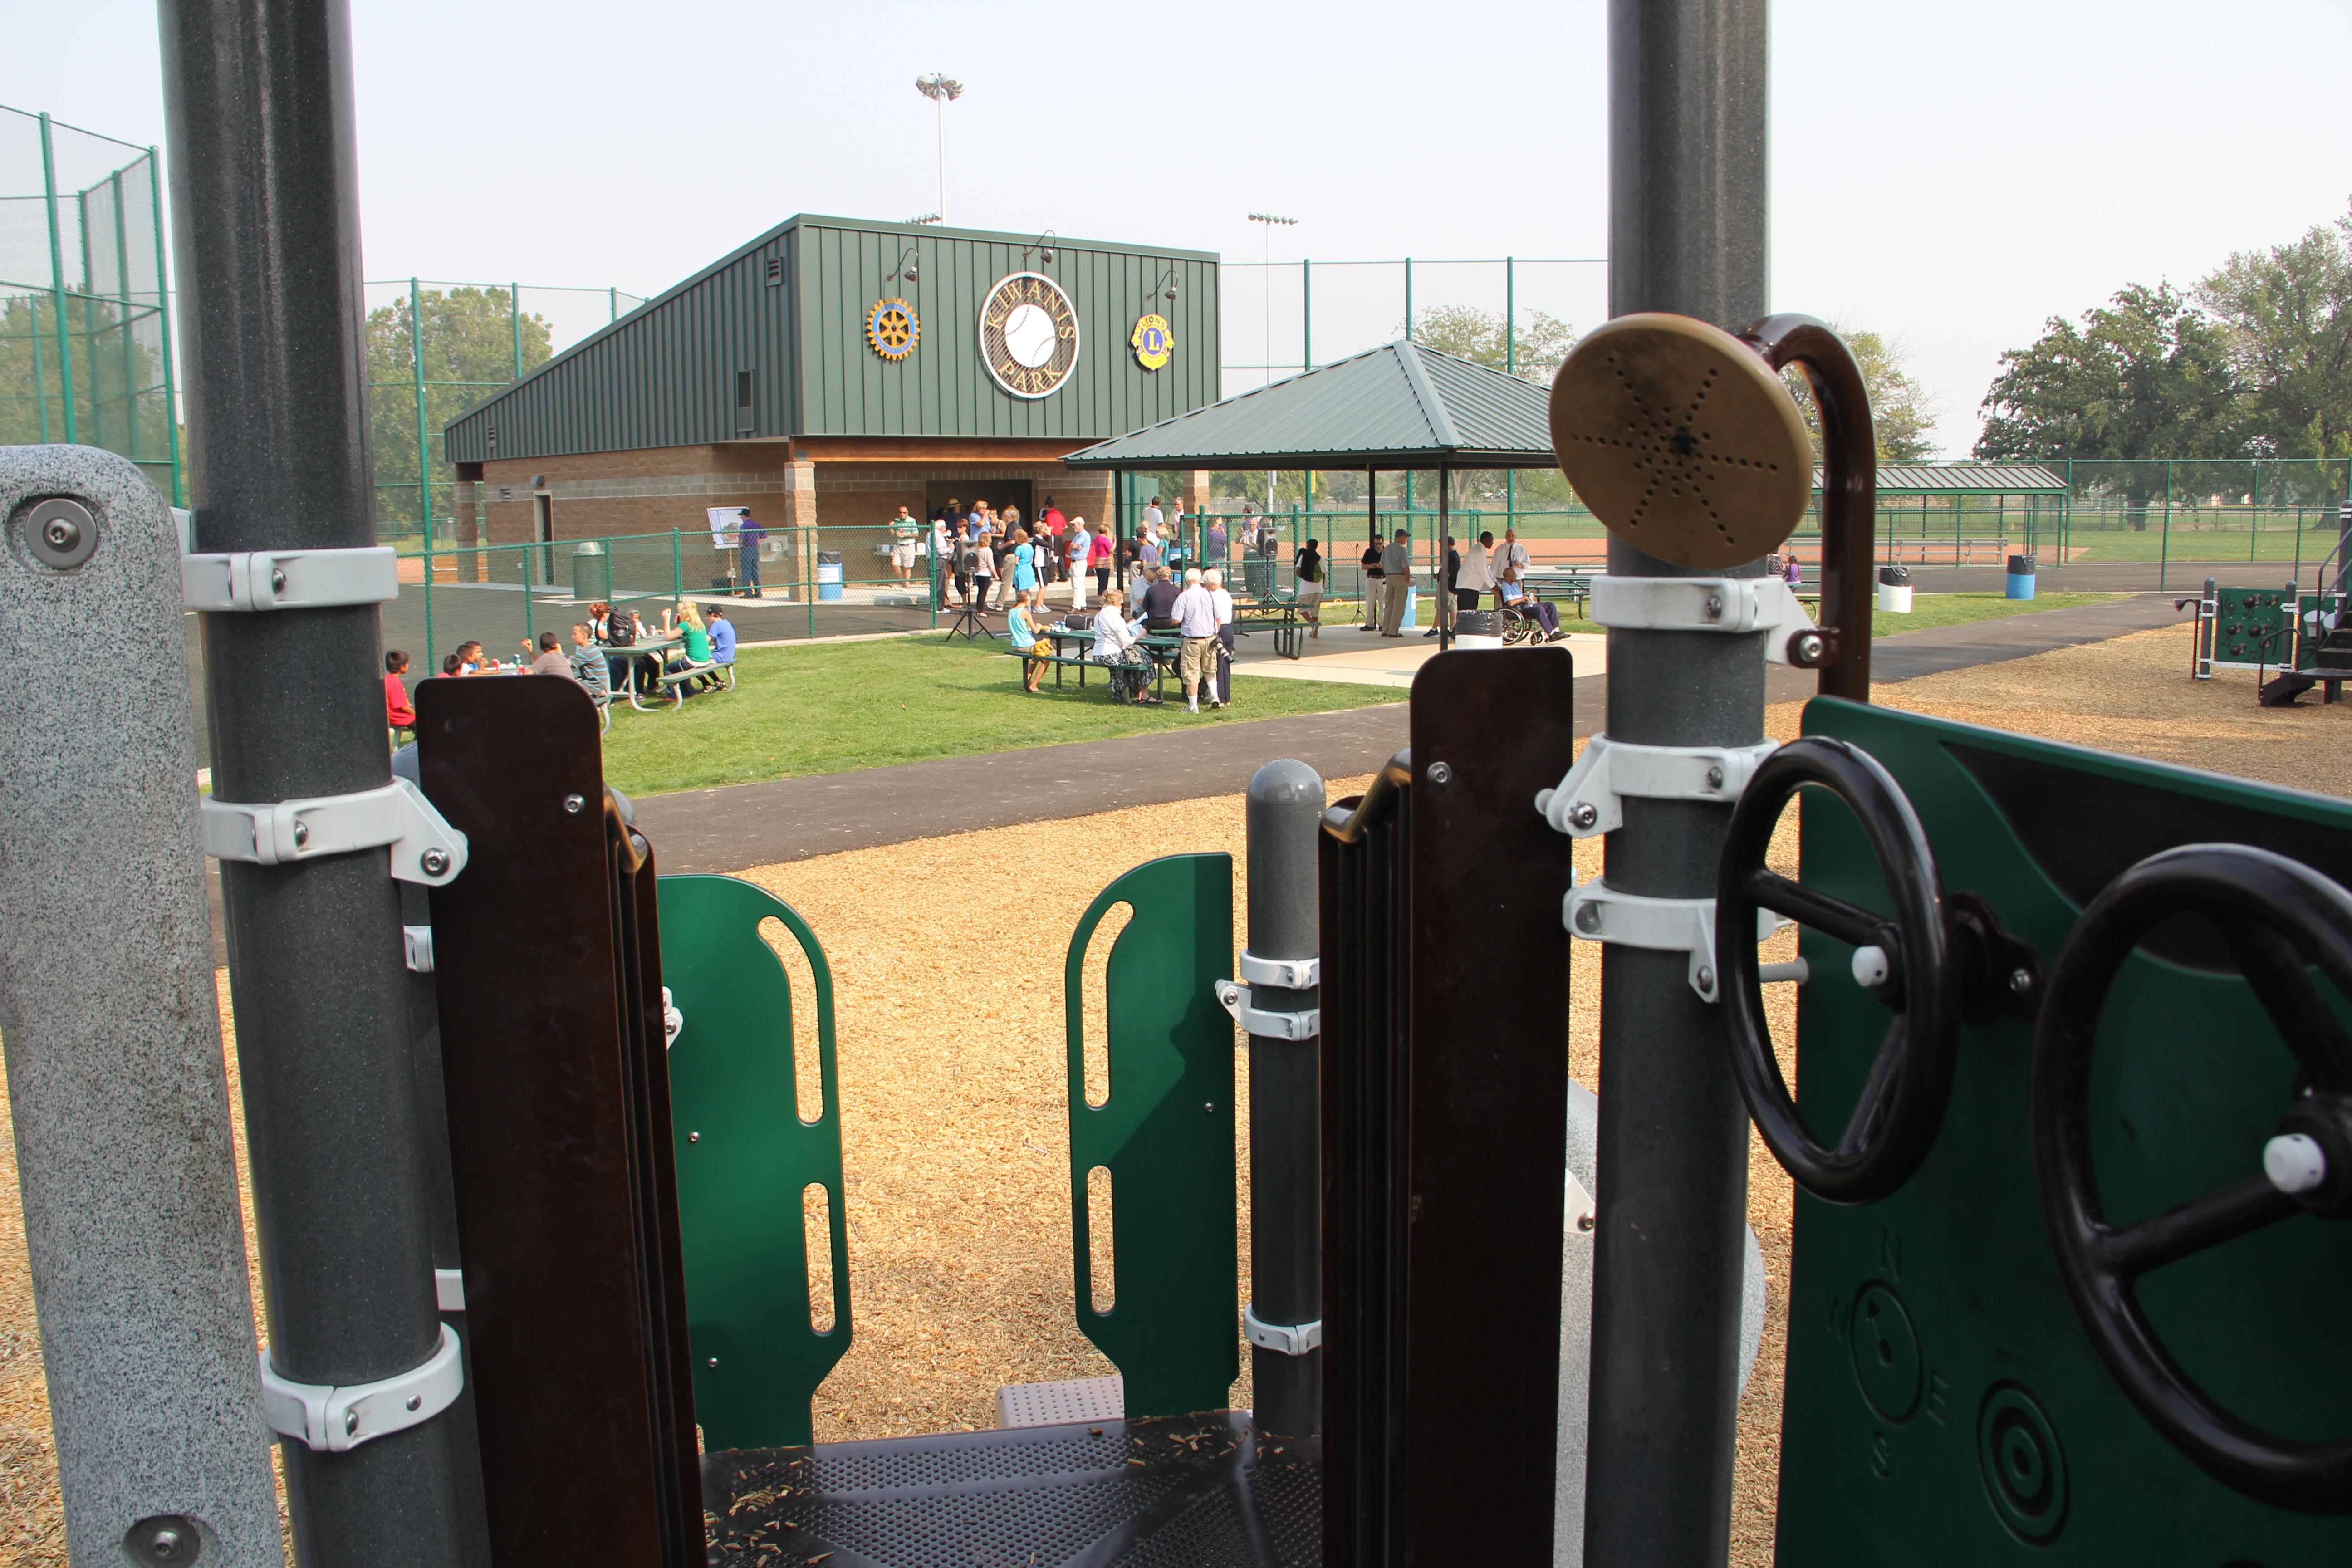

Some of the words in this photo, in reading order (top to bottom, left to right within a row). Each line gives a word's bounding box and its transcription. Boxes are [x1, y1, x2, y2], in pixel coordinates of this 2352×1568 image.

[986, 280, 1075, 339] KIWANIS
[1141, 316, 1166, 328] LIONS
[1148, 331, 1160, 350] L
[998, 360, 1063, 392] PARK
[1881, 1226, 1902, 1282] N
[1823, 1284, 1849, 1341] W
[1926, 1370, 1950, 1428] E
[1870, 1430, 1889, 1480] S
